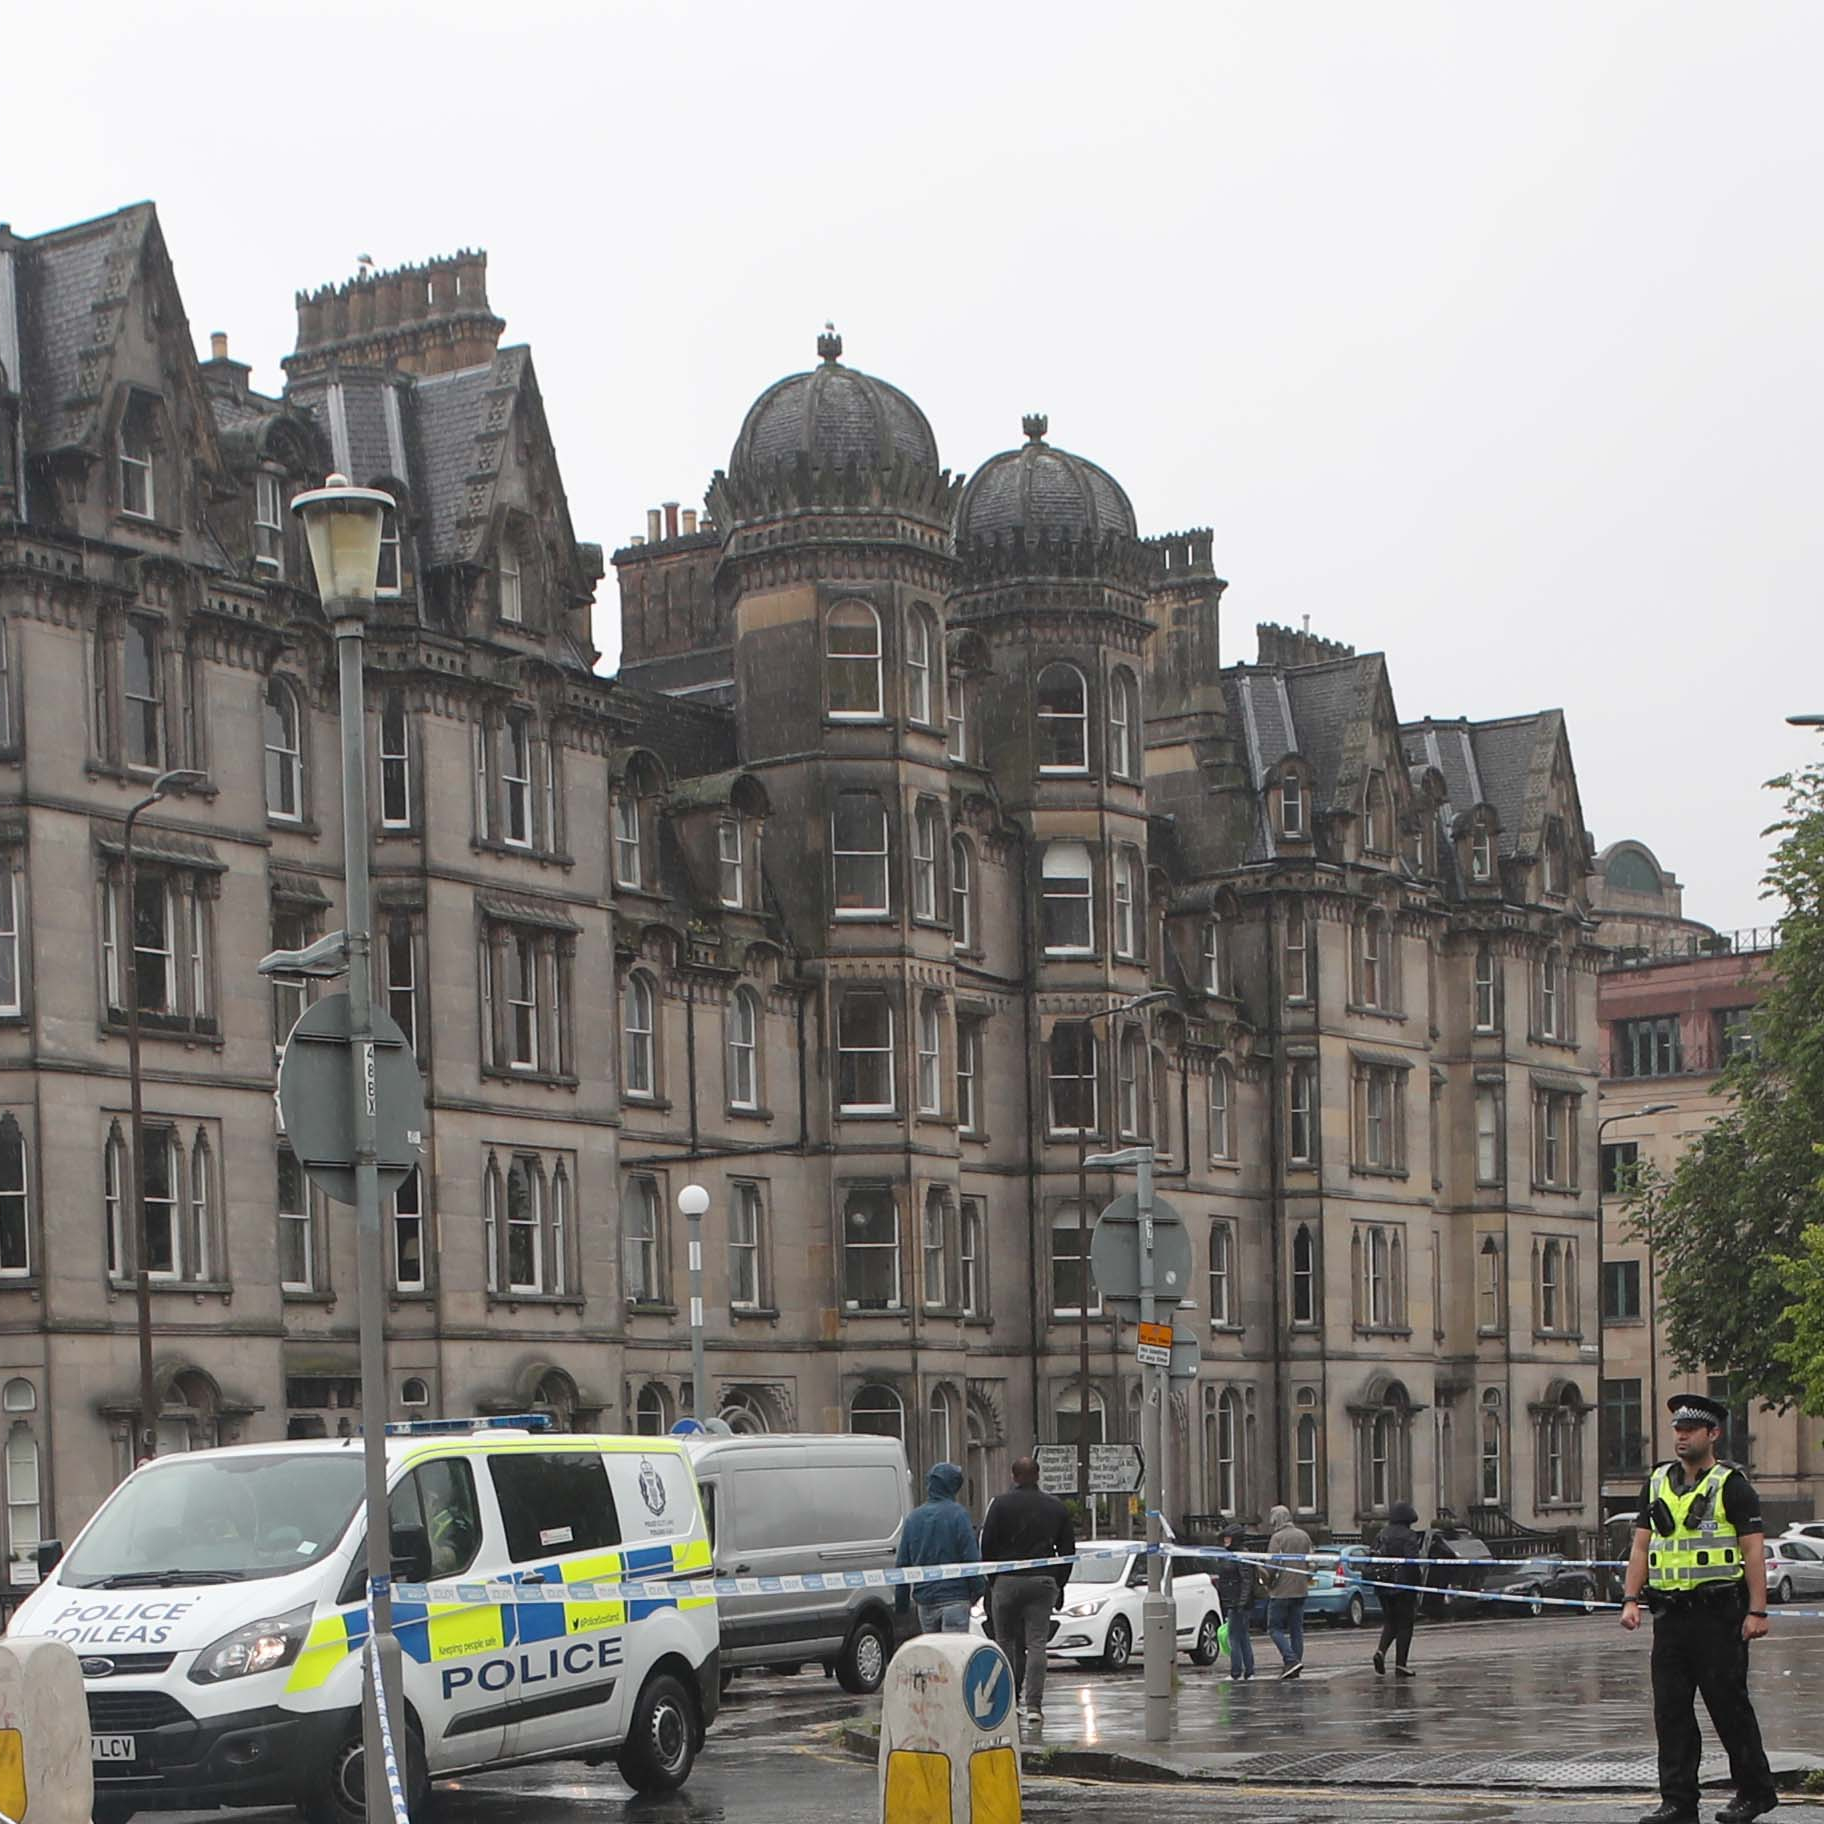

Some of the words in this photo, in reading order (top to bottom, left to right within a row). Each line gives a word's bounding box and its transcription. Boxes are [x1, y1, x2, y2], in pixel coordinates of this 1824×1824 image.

[53, 1603, 192, 1625] POLICE
[441, 1637, 623, 1700] POLICE
[100, 1739, 131, 1757] LCV
